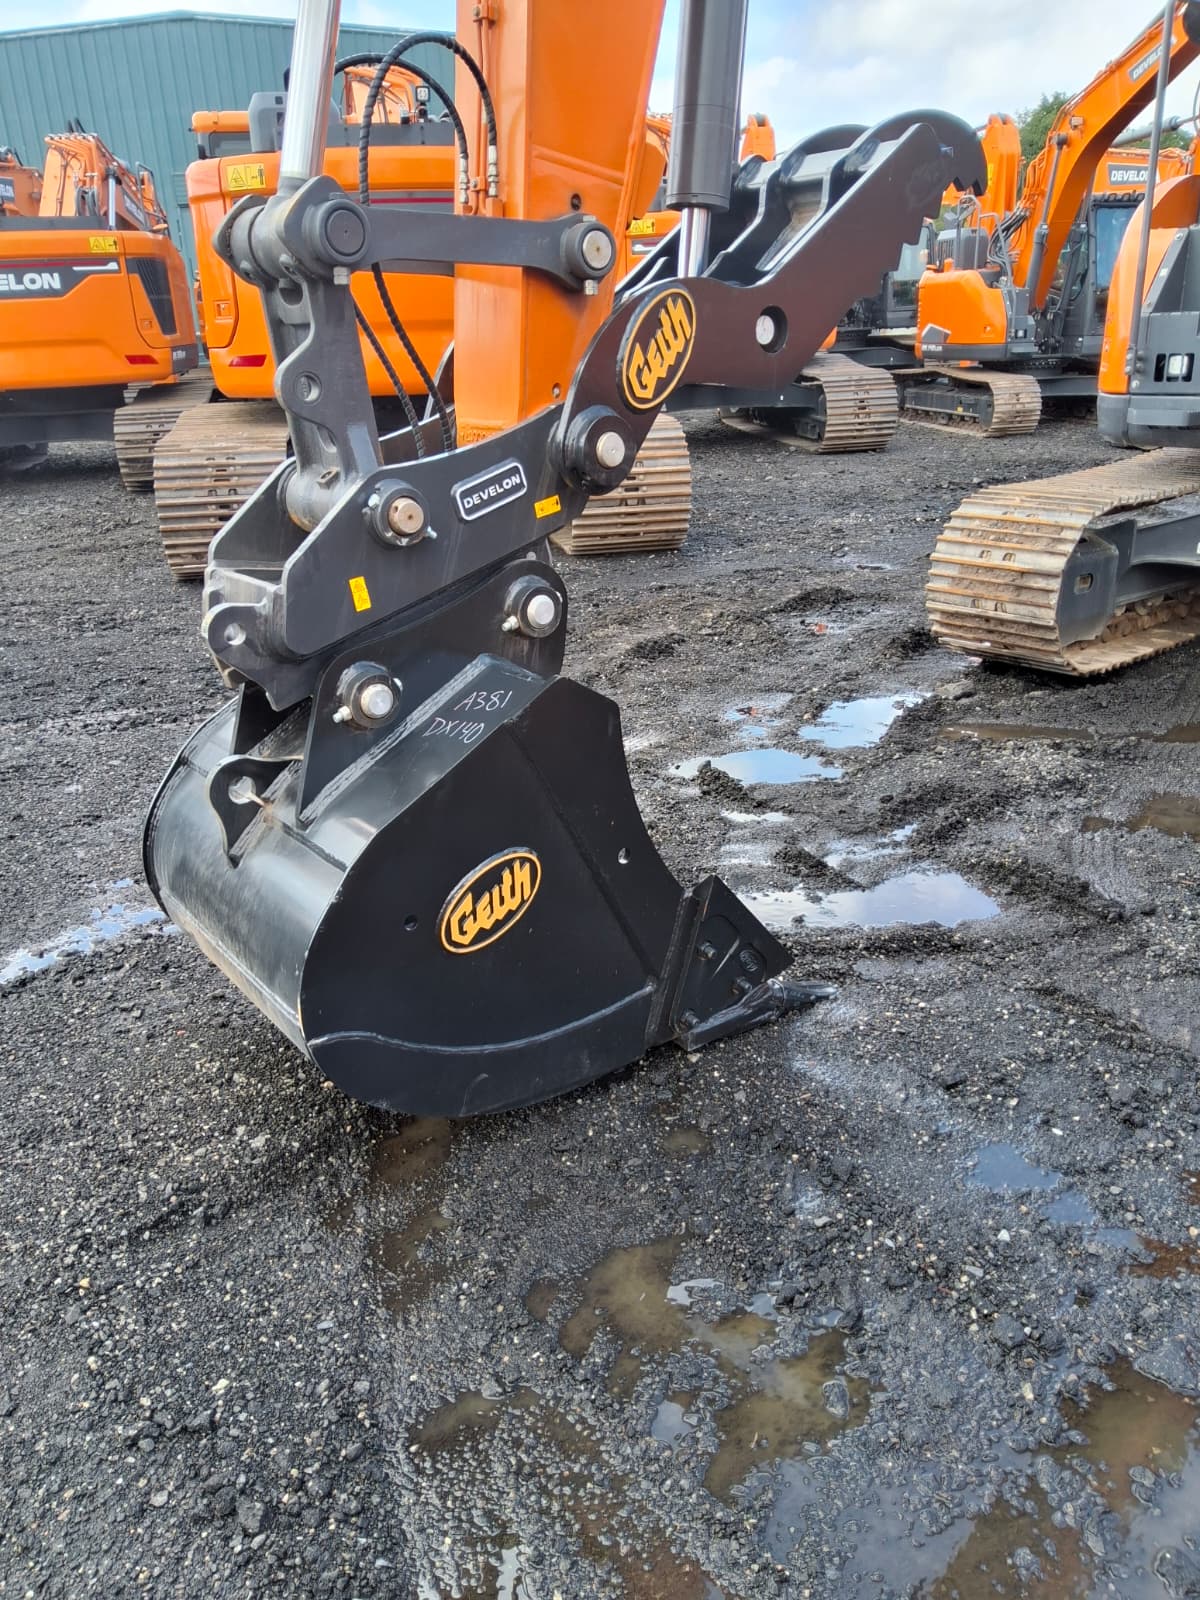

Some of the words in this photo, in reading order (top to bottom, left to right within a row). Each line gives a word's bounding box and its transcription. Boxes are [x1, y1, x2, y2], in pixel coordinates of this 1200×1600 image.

[628, 296, 692, 399] Geith
[463, 474, 521, 509] DEVELON
[453, 690, 513, 711] A381
[422, 717, 485, 744] DX140
[449, 859, 531, 945] Geith
